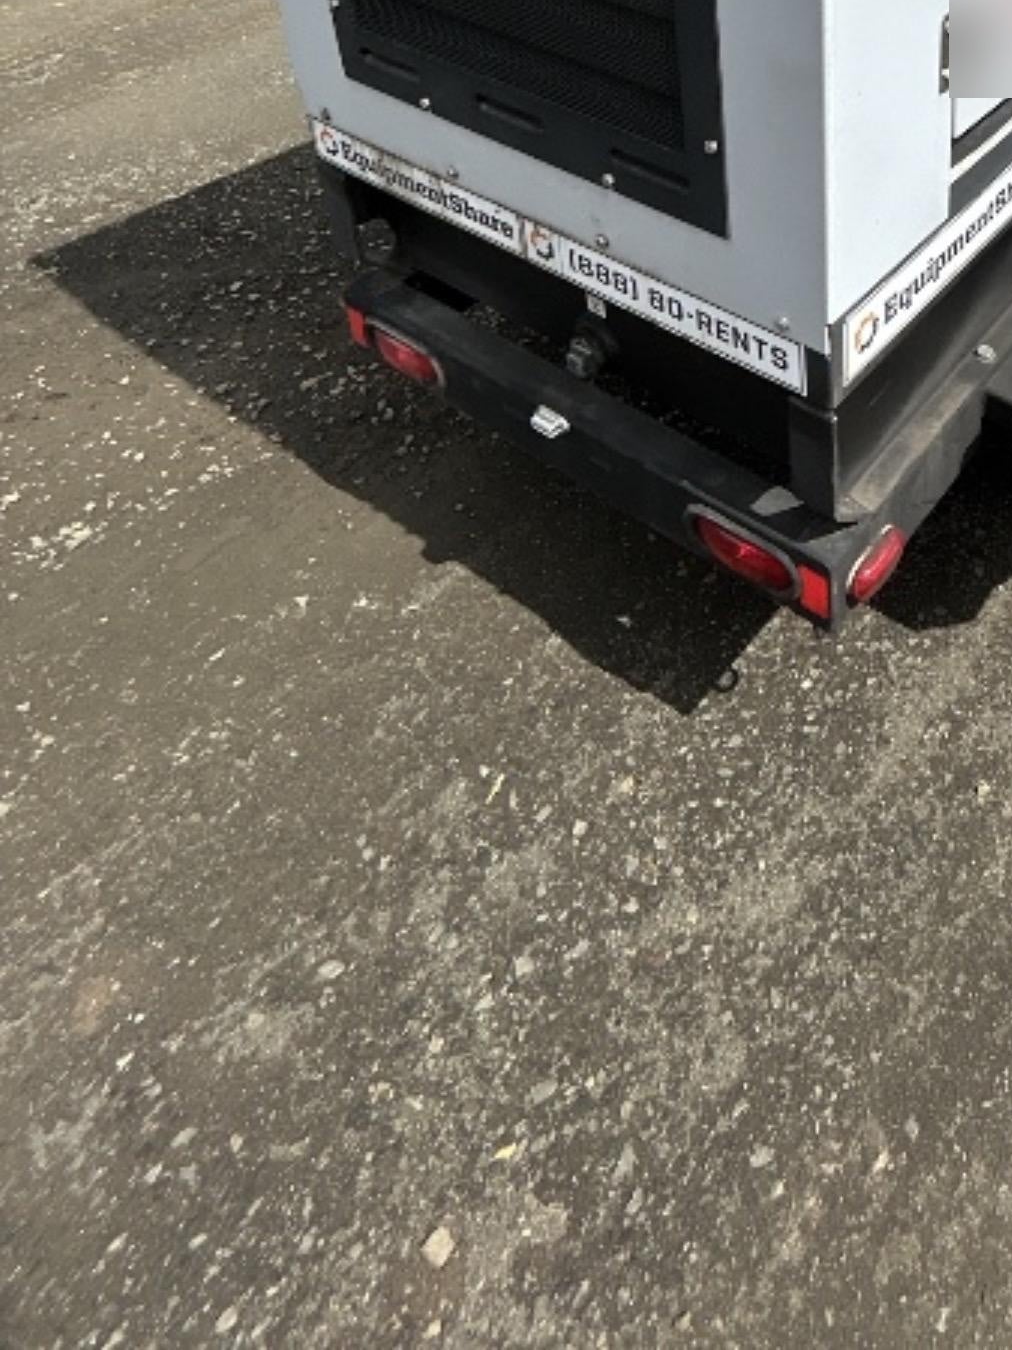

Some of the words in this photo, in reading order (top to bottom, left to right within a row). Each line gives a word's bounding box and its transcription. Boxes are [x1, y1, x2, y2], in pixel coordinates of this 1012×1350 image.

[341, 141, 514, 239] EquipmentShare
[568, 248, 639, 301] (888)
[648, 286, 789, 371] 80-RENTS
